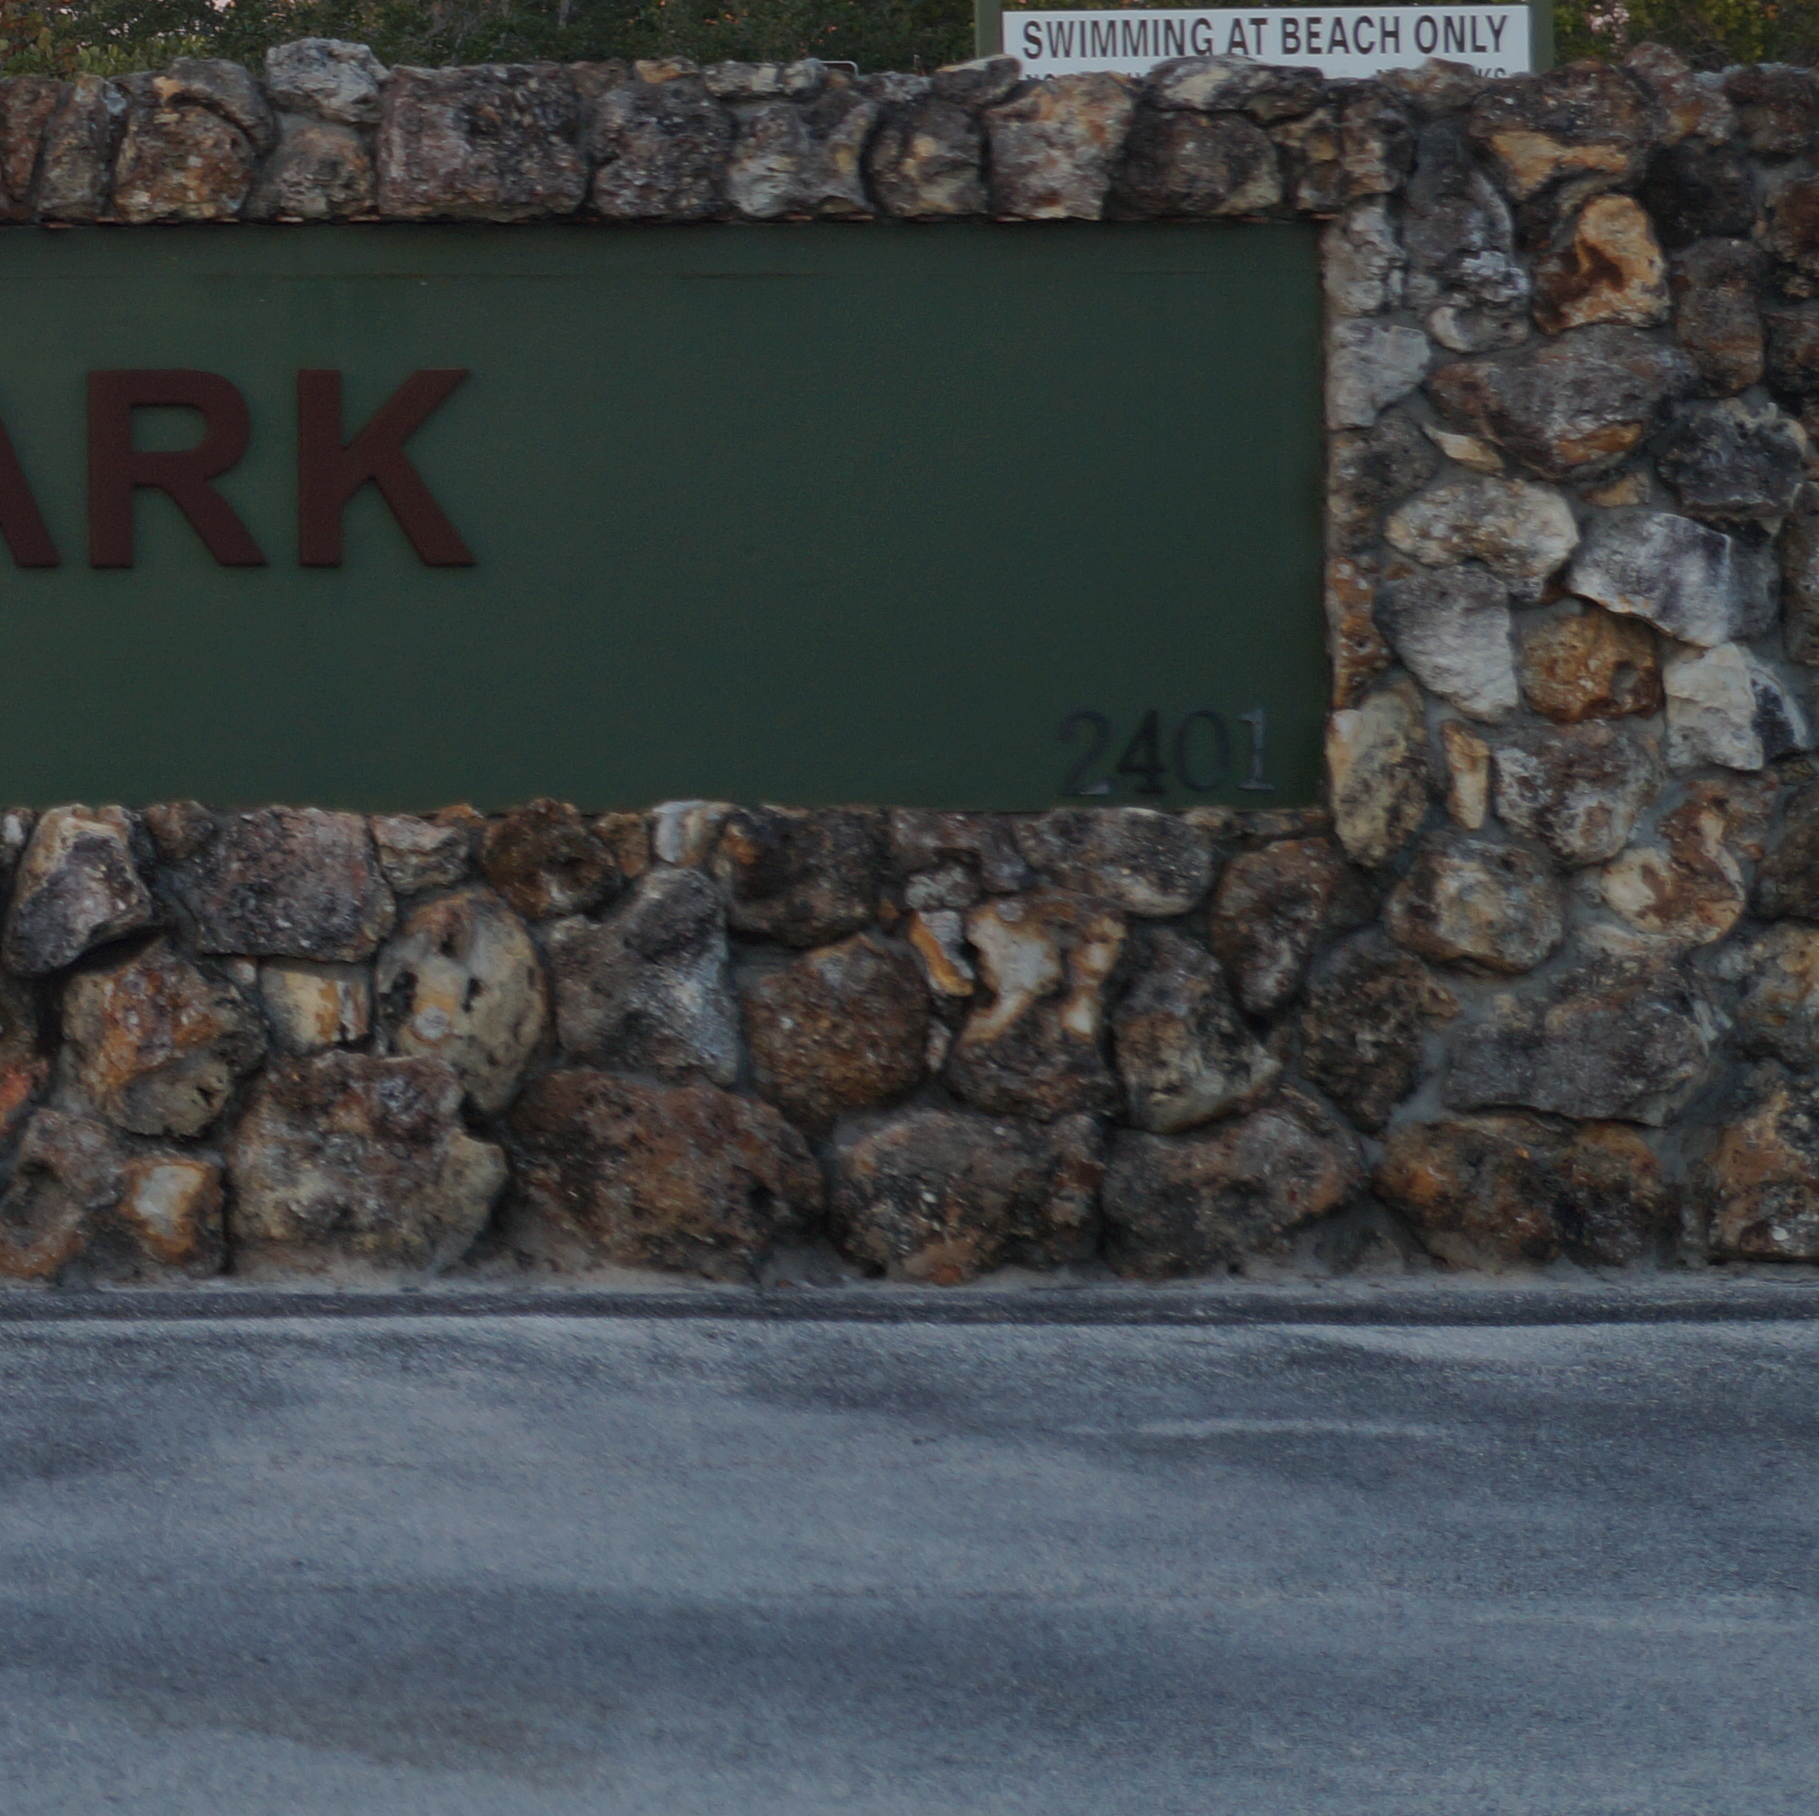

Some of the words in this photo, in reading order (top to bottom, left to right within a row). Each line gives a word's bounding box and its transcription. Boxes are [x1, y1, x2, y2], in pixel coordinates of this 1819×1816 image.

[1022, 17, 1214, 60] SWIMMING
[1226, 16, 1268, 56] AT
[1281, 14, 1401, 55] BEACH
[1413, 14, 1508, 54] ONLY
[1059, 707, 1275, 797] 2401
